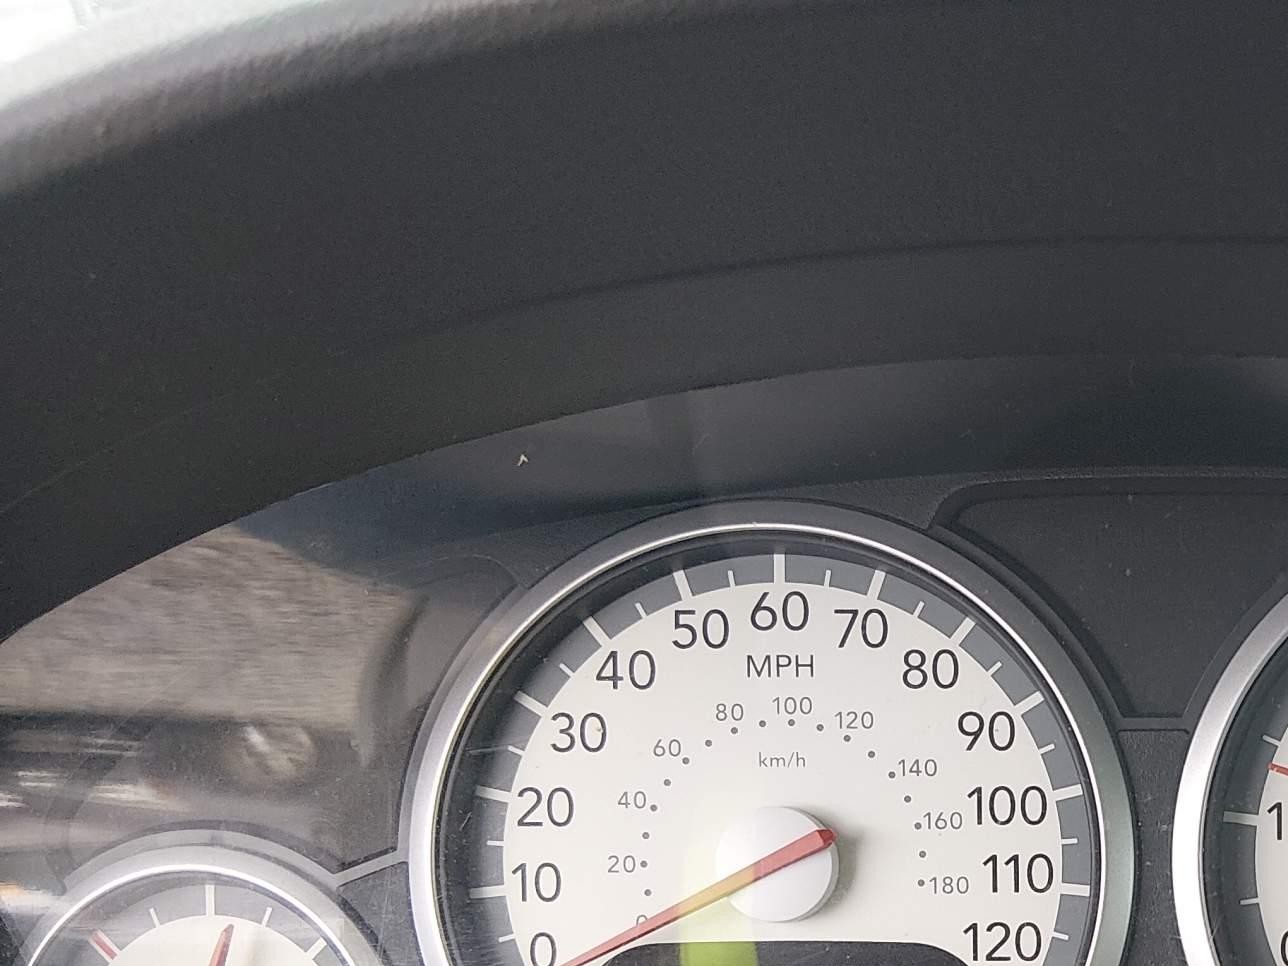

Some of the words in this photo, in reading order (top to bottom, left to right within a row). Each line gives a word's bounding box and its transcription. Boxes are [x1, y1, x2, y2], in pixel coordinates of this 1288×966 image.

[672, 609, 729, 649] 50
[751, 591, 809, 631] 60
[834, 609, 888, 648] 70
[595, 650, 655, 690] 40
[747, 655, 813, 677] MPH
[903, 649, 958, 689] 80
[716, 704, 743, 721] 80
[773, 697, 812, 714] 100
[835, 711, 873, 729] 120
[551, 713, 606, 752] 30
[653, 739, 681, 757] 60
[958, 711, 1015, 751] 90
[759, 752, 805, 768] km/h
[899, 759, 937, 776] 140
[517, 787, 573, 827] 20
[618, 791, 646, 809] 40
[968, 786, 1047, 825] 100
[923, 812, 962, 830] 160
[1267, 802, 1282, 840] 1
[512, 863, 561, 902] 10
[608, 855, 636, 873] 20
[983, 854, 1053, 893] 110
[930, 876, 969, 894] 180
[963, 923, 1041, 962] 120
